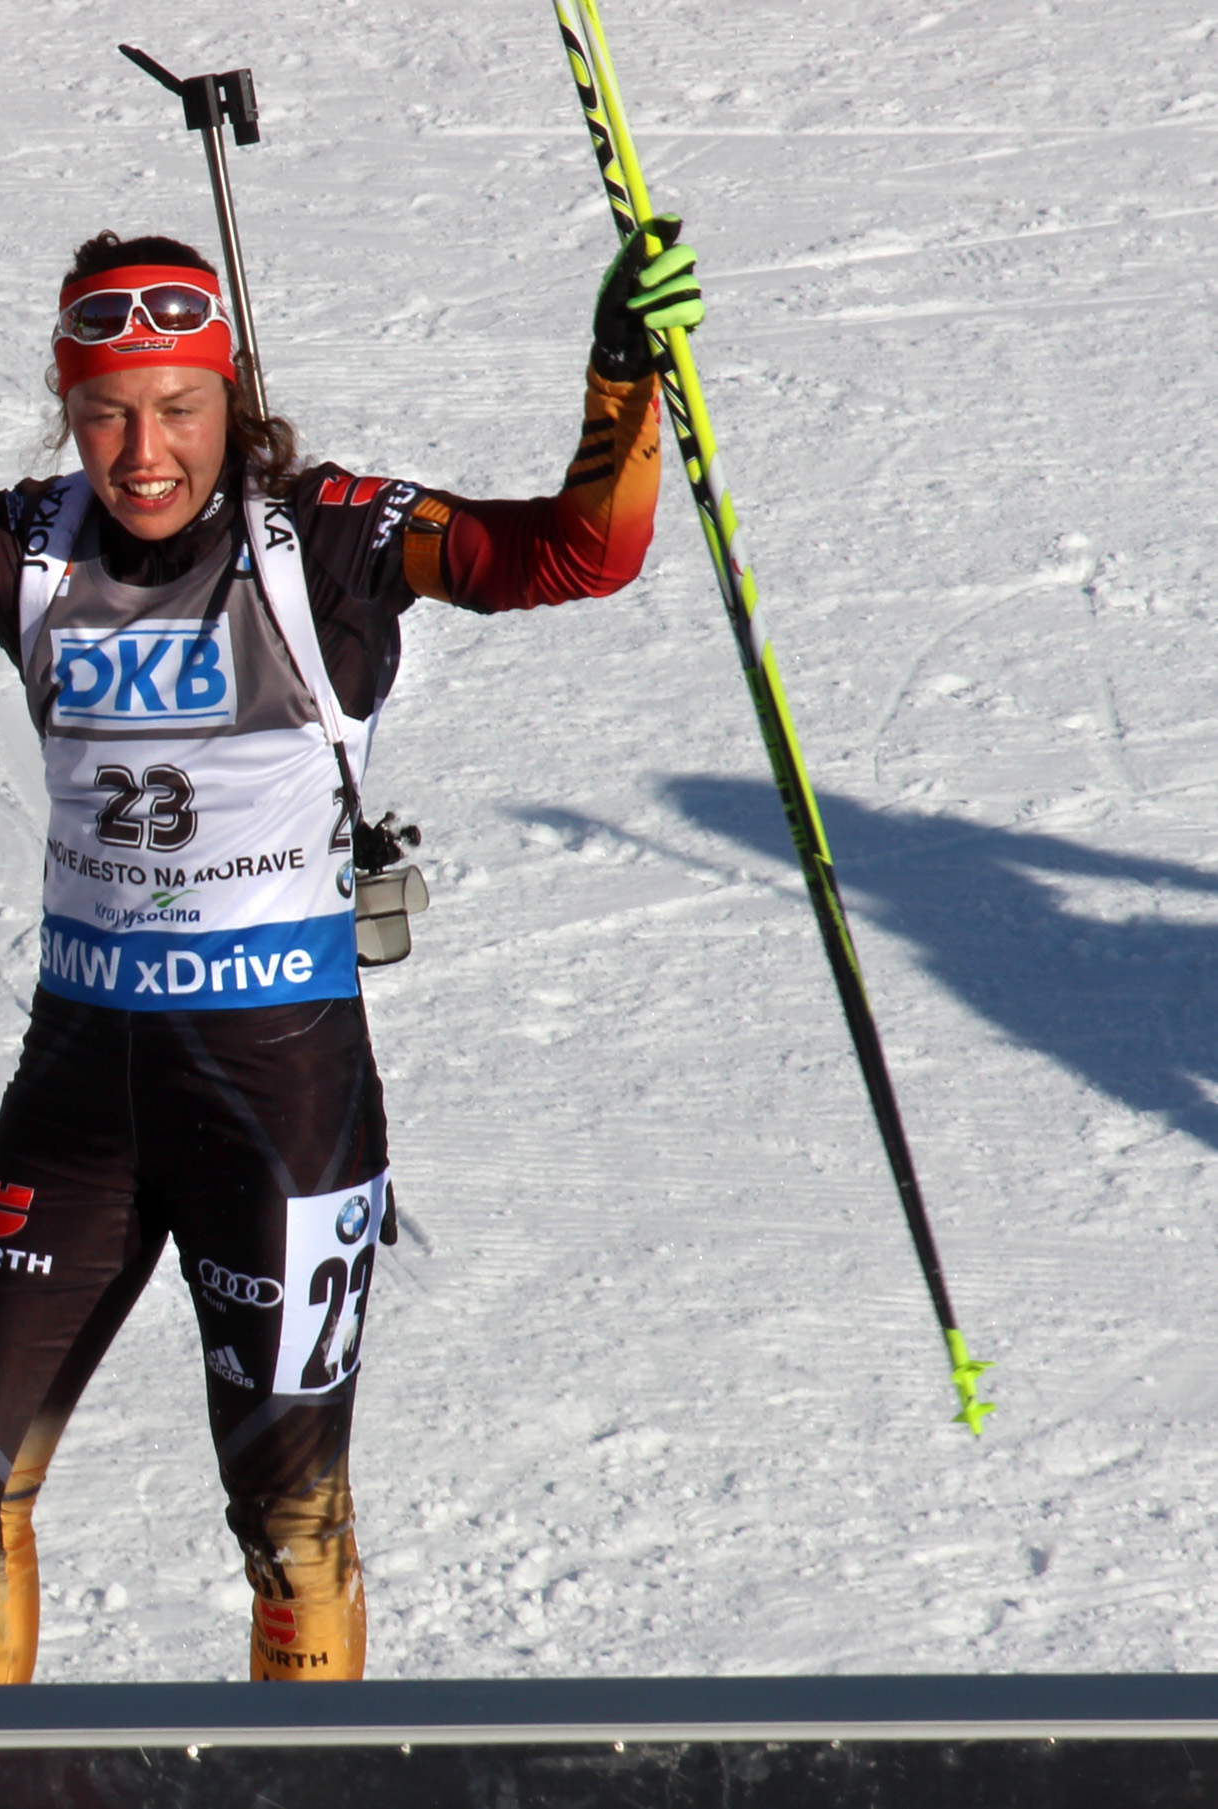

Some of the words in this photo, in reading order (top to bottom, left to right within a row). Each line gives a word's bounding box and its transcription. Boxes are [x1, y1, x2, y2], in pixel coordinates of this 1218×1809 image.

[55, 637, 227, 712] DKB
[94, 763, 198, 853] 23
[154, 868, 187, 888] NA
[194, 848, 305, 884] MORAVE
[40, 926, 122, 991] BMW
[134, 945, 314, 995] xDrive
[300, 1243, 375, 1389] 23
